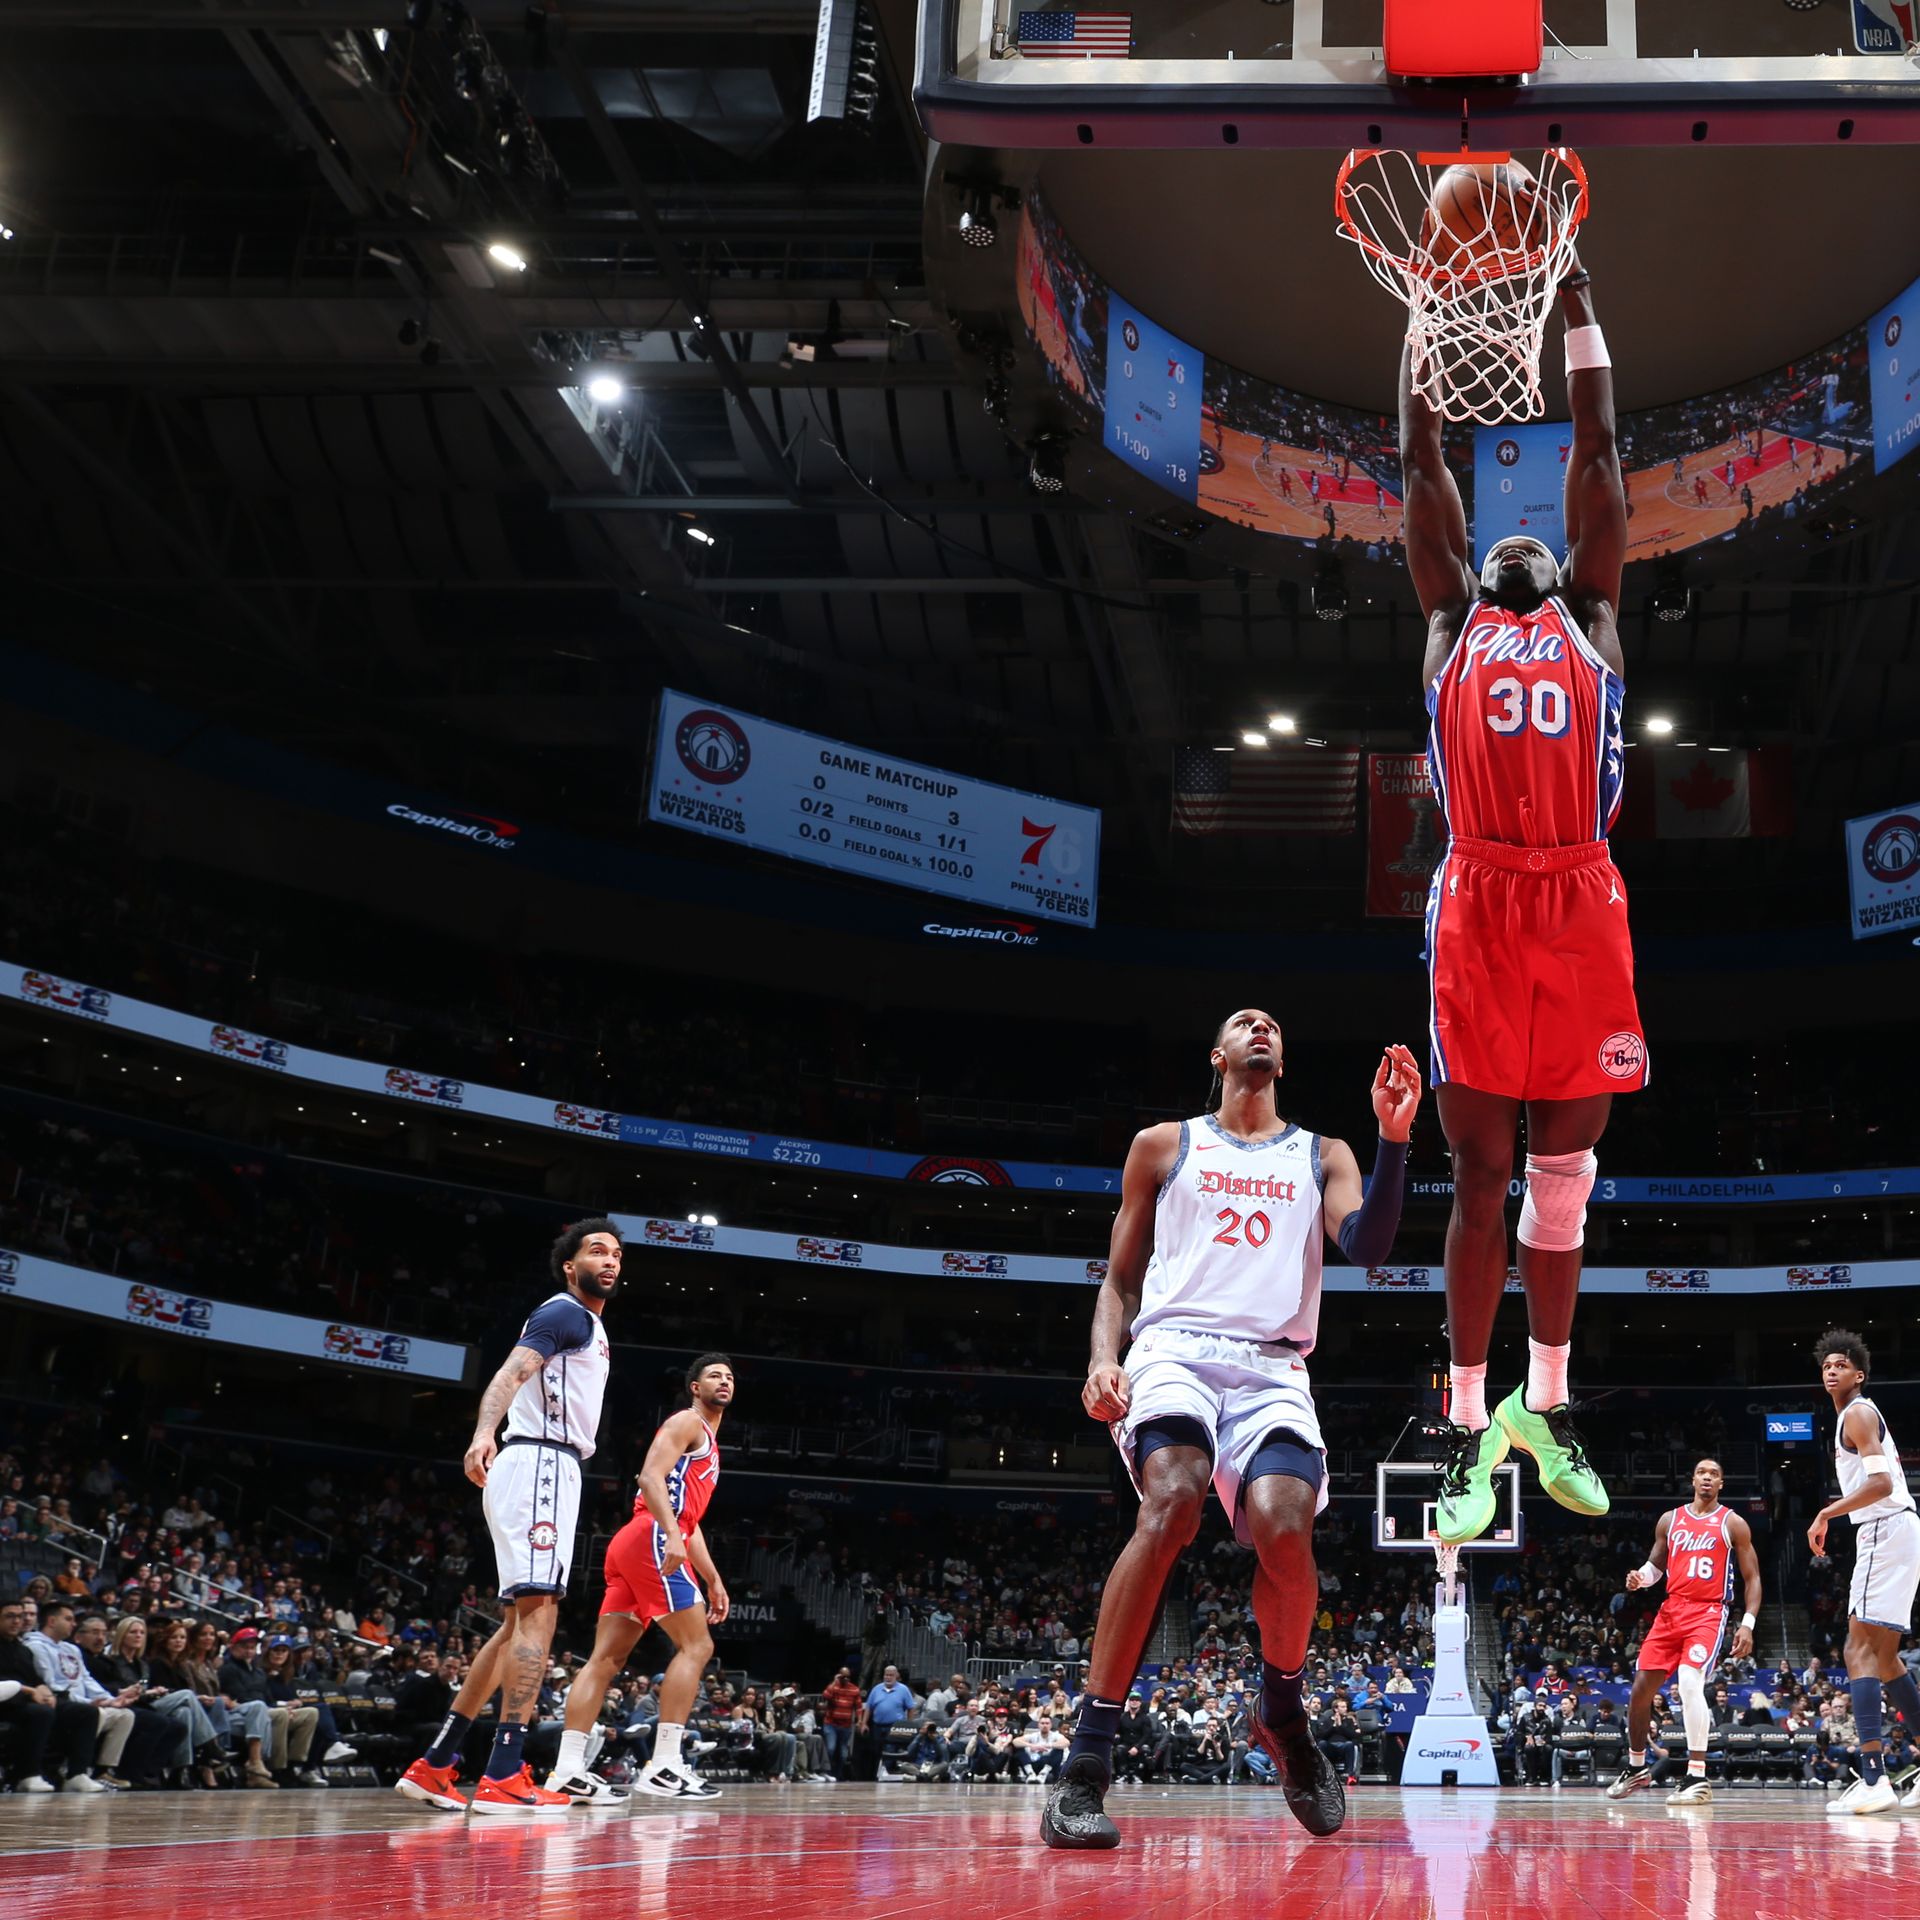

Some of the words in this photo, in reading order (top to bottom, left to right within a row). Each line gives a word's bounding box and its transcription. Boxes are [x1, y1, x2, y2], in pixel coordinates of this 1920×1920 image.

[1863, 28, 1893, 47] NBA
[1124, 361, 1133, 379] 0
[1889, 358, 1899, 376] 0
[1168, 391, 1176, 409] 3
[1115, 426, 1150, 461] 11:00
[1500, 478, 1513, 494] 0
[1523, 503, 1555, 513] QUARTER
[1459, 623, 1564, 683] Phila
[1487, 677, 1570, 738] 30
[820, 750, 871, 776] GAME
[875, 766, 958, 798] MATCHUP
[660, 789, 742, 821] WASHINGTON
[813, 775, 826, 790] 0
[866, 794, 909, 813] POINTS
[948, 811, 960, 826] 3
[660, 800, 746, 834] WIZARDS
[800, 797, 834, 818] 0/2
[849, 815, 881, 831] FIELD
[884, 824, 922, 842] GOALS
[938, 833, 967, 853] 1/1
[799, 823, 831, 843] 0.0
[844, 840, 877, 856] FIELD
[880, 848, 910, 865] GOAL
[912, 856, 922, 868] %
[929, 856, 974, 879] 100.0
[1010, 881, 1090, 906] PHILADELPHIA
[1036, 895, 1089, 918] 76ERS
[1604, 1050, 1639, 1066] 76ers
[625, 1125, 644, 1135] 7:15
[646, 1127, 658, 1136] PM
[694, 1132, 750, 1146] FOUNDATION
[692, 1141, 718, 1152] 50/50
[720, 1144, 750, 1156] RAFFLE
[778, 1140, 811, 1150] JACKPOT
[772, 1148, 821, 1165] $2,270
[1055, 1176, 1064, 1188] 0
[1104, 1180, 1112, 1190] 7
[1197, 1170, 1296, 1202] District
[1412, 1182, 1430, 1193] 1st
[1432, 1181, 1455, 1194] QTR
[1602, 1180, 1616, 1200] 3
[1648, 1182, 1775, 1198] PHILADELPHIA
[1833, 1184, 1842, 1194] 0
[1880, 1181, 1888, 1192] 7
[1213, 1207, 1273, 1249] 20
[1671, 1529, 1717, 1557] Phila
[1687, 1556, 1714, 1580] 16
[890, 1726, 918, 1734] CAESARS
